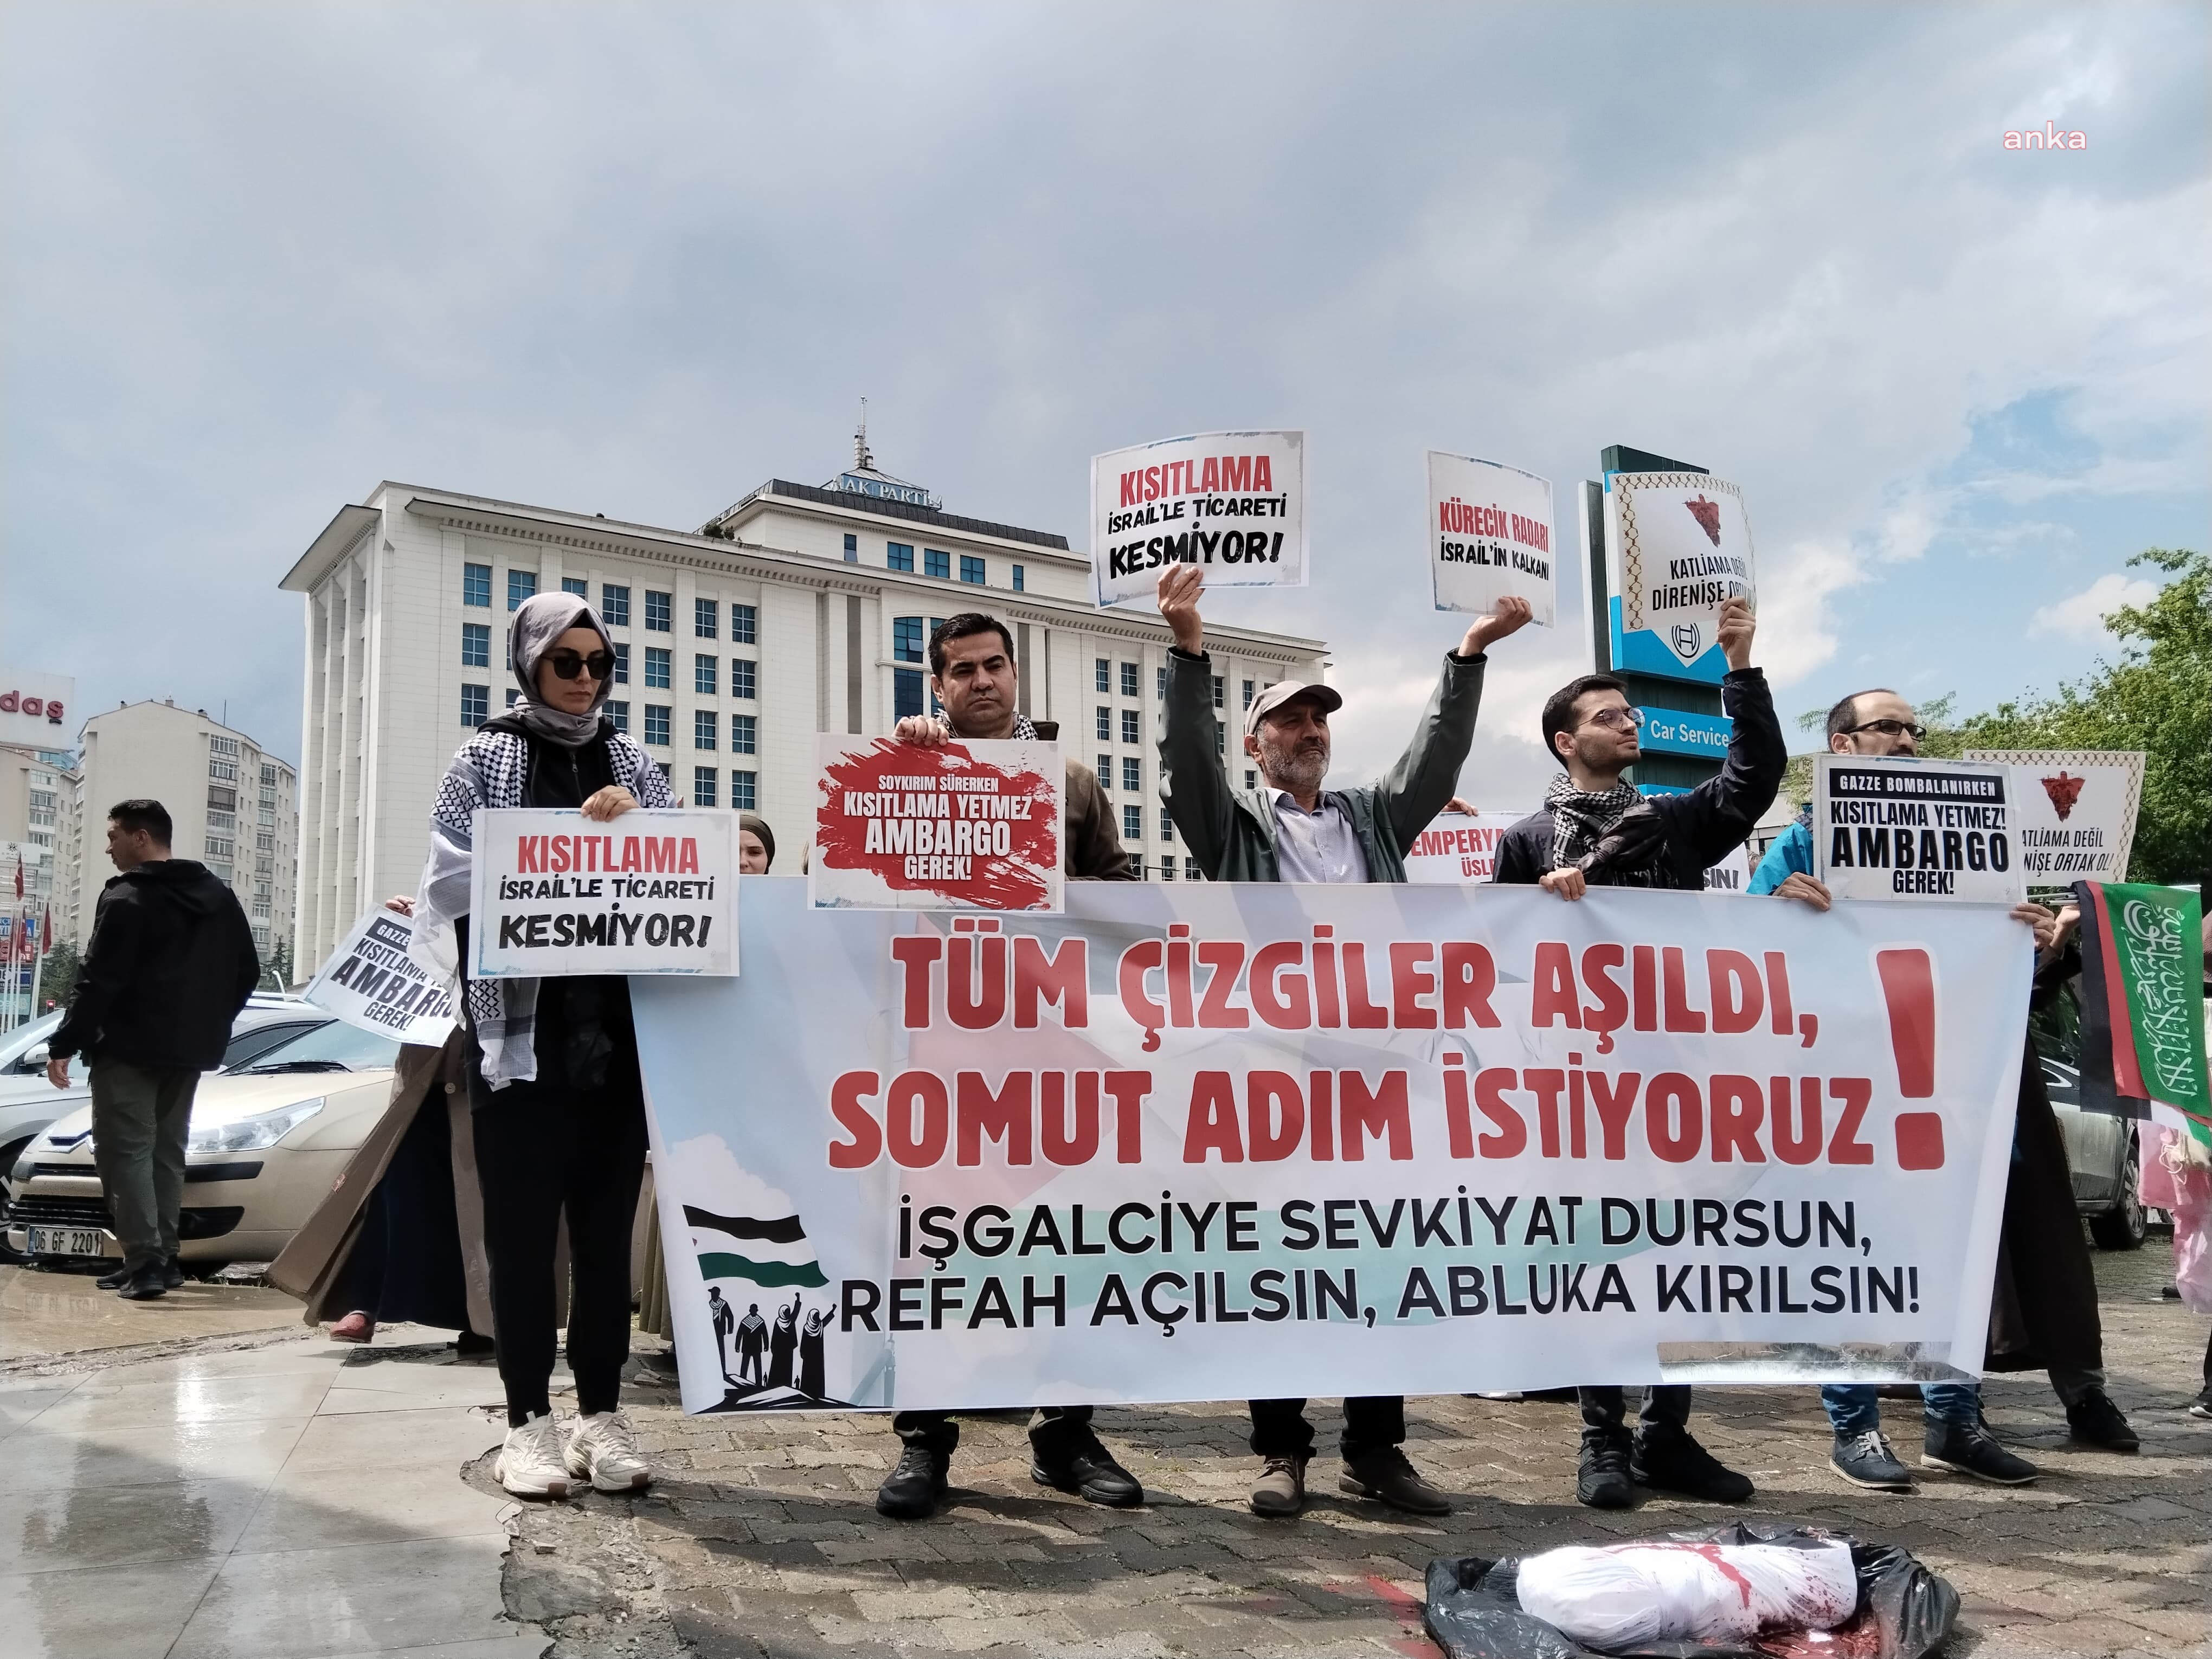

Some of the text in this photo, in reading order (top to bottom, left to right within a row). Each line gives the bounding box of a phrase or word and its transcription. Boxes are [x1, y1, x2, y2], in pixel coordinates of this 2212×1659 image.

[845, 478, 870, 494] AK
[1120, 455, 1273, 508] KISITLAMA
[1108, 492, 1287, 535] İSRAİL'LE TİCARETİ
[1439, 497, 1548, 554] KÜRECİK RADARI
[1110, 521, 1284, 580] KESMİYOR!
[1441, 535, 1549, 581] İSRAİL'İN KALKANI
[1670, 553, 1733, 580] KATLİAMA
[1652, 579, 1725, 610] DİRENİŞE
[0, 690, 64, 725] daş
[1650, 719, 1730, 748] Car Service
[878, 773, 999, 793] SOYKIRIM SÜRERKEN
[1840, 775, 1996, 796] GAZZE BOMBALANIRKEN
[844, 792, 1032, 820] KISITLAMA YETMEZ
[1830, 801, 2007, 830] KISITLAMA YETMEZ!
[864, 819, 1012, 857] AMBARGO
[1831, 826, 2009, 873] AMBARGO
[2022, 826, 2104, 847] ATLİAMA DEĞİL
[518, 835, 699, 874] KISITLAMA
[904, 855, 972, 881] GEREK!
[2024, 849, 2114, 877] NİŞE ORTAK OL!
[499, 873, 715, 901] İSRAİL'LE TİCARETİ
[1703, 867, 1739, 890] SIN!
[1893, 870, 1954, 895] GEREK!
[498, 902, 712, 949] KESMİYOR!
[892, 918, 1819, 1055] TÜM ÇİZGİLER AŞILDI,
[363, 1001, 416, 1031] GEREK!
[828, 1052, 1874, 1168] SOMUT ADIM İSTİYORUZ
[35, 1230, 99, 1254] 06 GF 2201
[899, 1185, 1872, 1271] İŞGALCİYE SEVKİYAT DURSUN,
[841, 1263, 1920, 1337] REFAH AÇILSIN, ABLUKA KIRILSIN!
